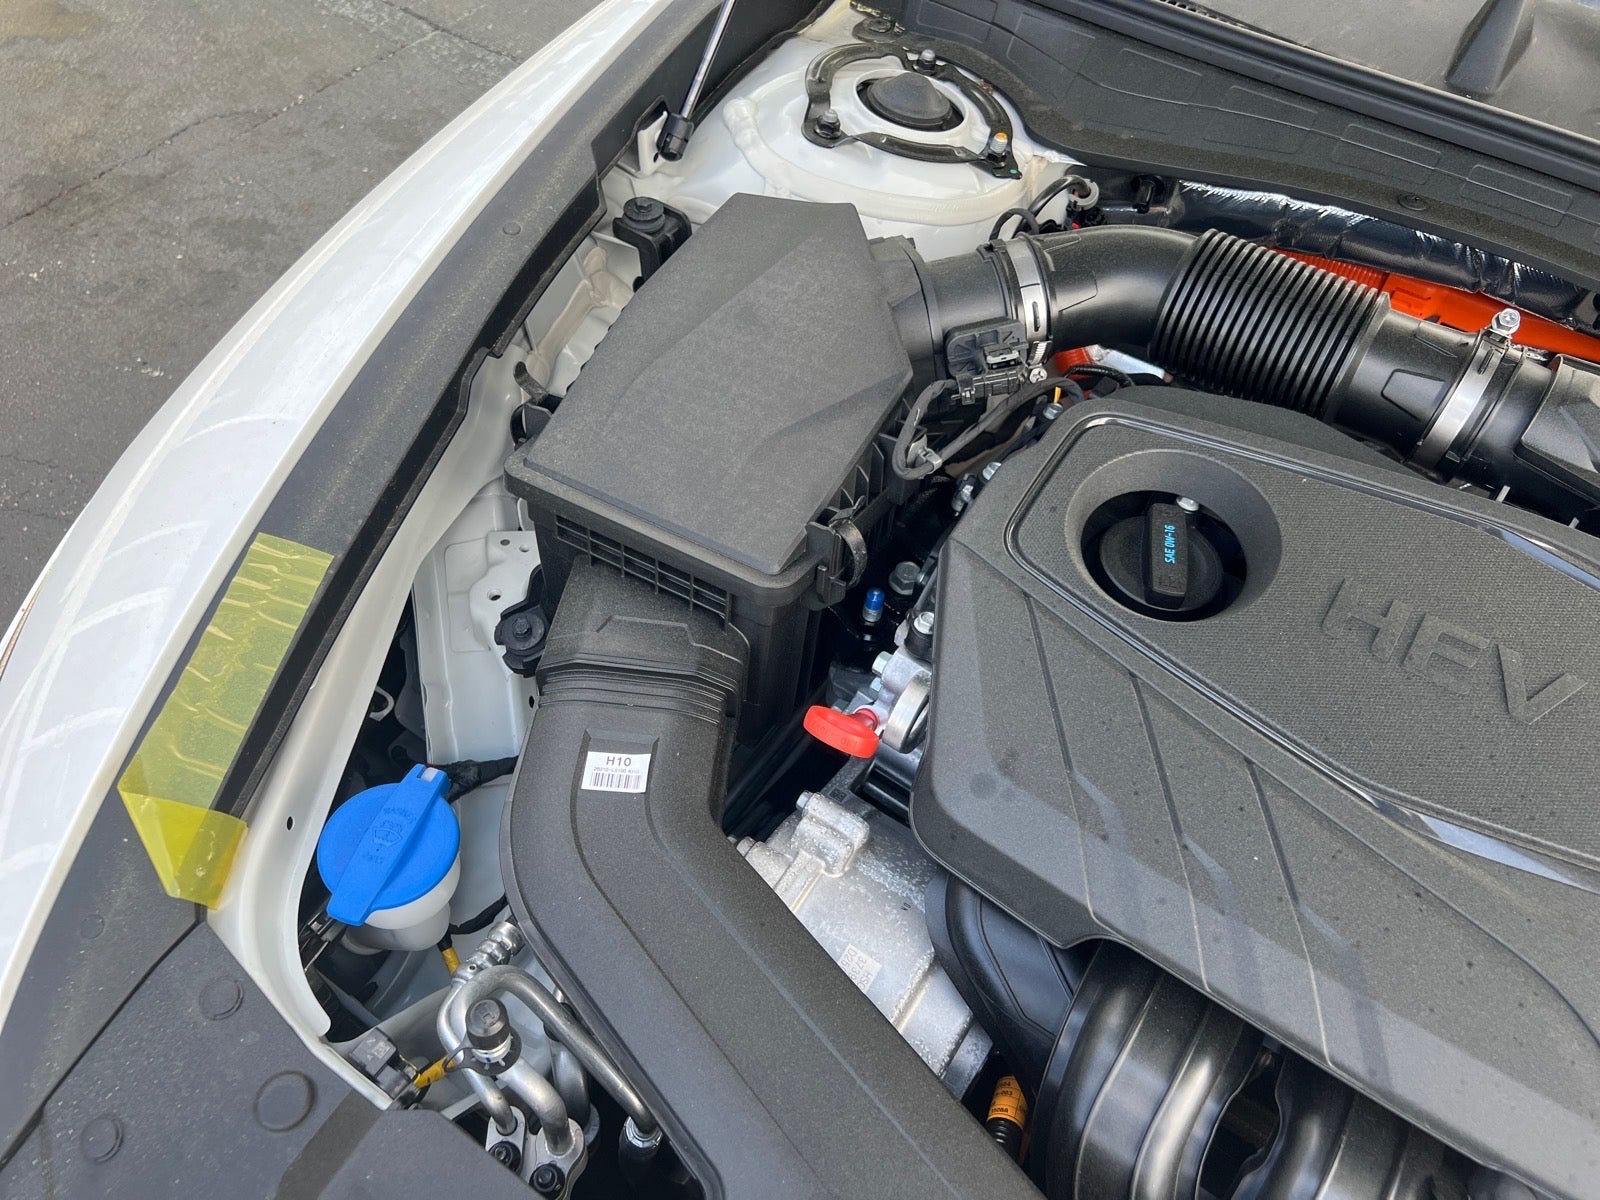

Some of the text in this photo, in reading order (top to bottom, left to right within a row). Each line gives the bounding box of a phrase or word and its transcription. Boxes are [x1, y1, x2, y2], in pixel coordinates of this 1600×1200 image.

[1164, 524, 1176, 564] SAE 0W-16
[1319, 577, 1589, 726] HEV
[606, 755, 632, 767] H10
